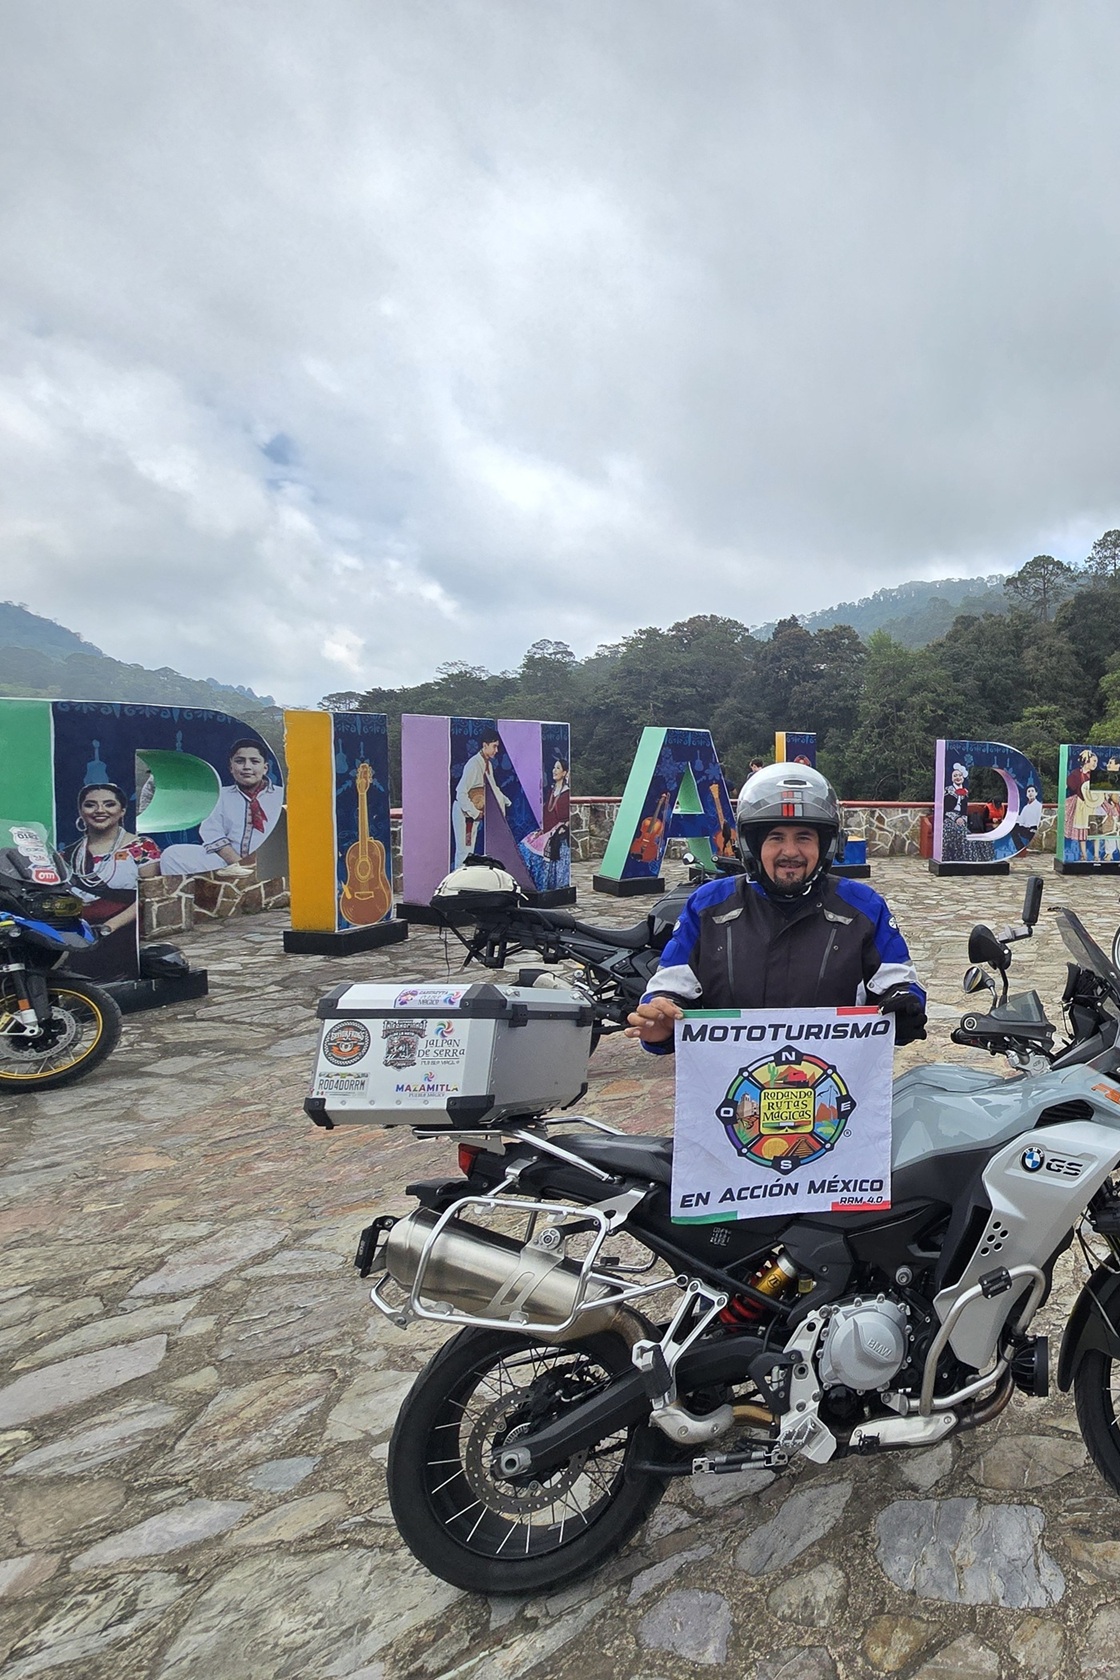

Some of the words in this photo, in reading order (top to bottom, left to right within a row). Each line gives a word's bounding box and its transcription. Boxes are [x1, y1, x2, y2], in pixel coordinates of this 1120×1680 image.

[782, 1052, 796, 1061] N
[395, 1084, 459, 1092] MAZAMITLA
[841, 1101, 851, 1112] E
[780, 1159, 792, 1169] S
[1046, 1158, 1083, 1176] GS
[679, 1191, 711, 1209] EN
[718, 1177, 799, 1204] ACCIÓN
[807, 1174, 884, 1195] MÉXICO
[839, 1196, 864, 1204] RRM
[866, 1195, 884, 1204] 4.0
[866, 1337, 892, 1357] BMW
